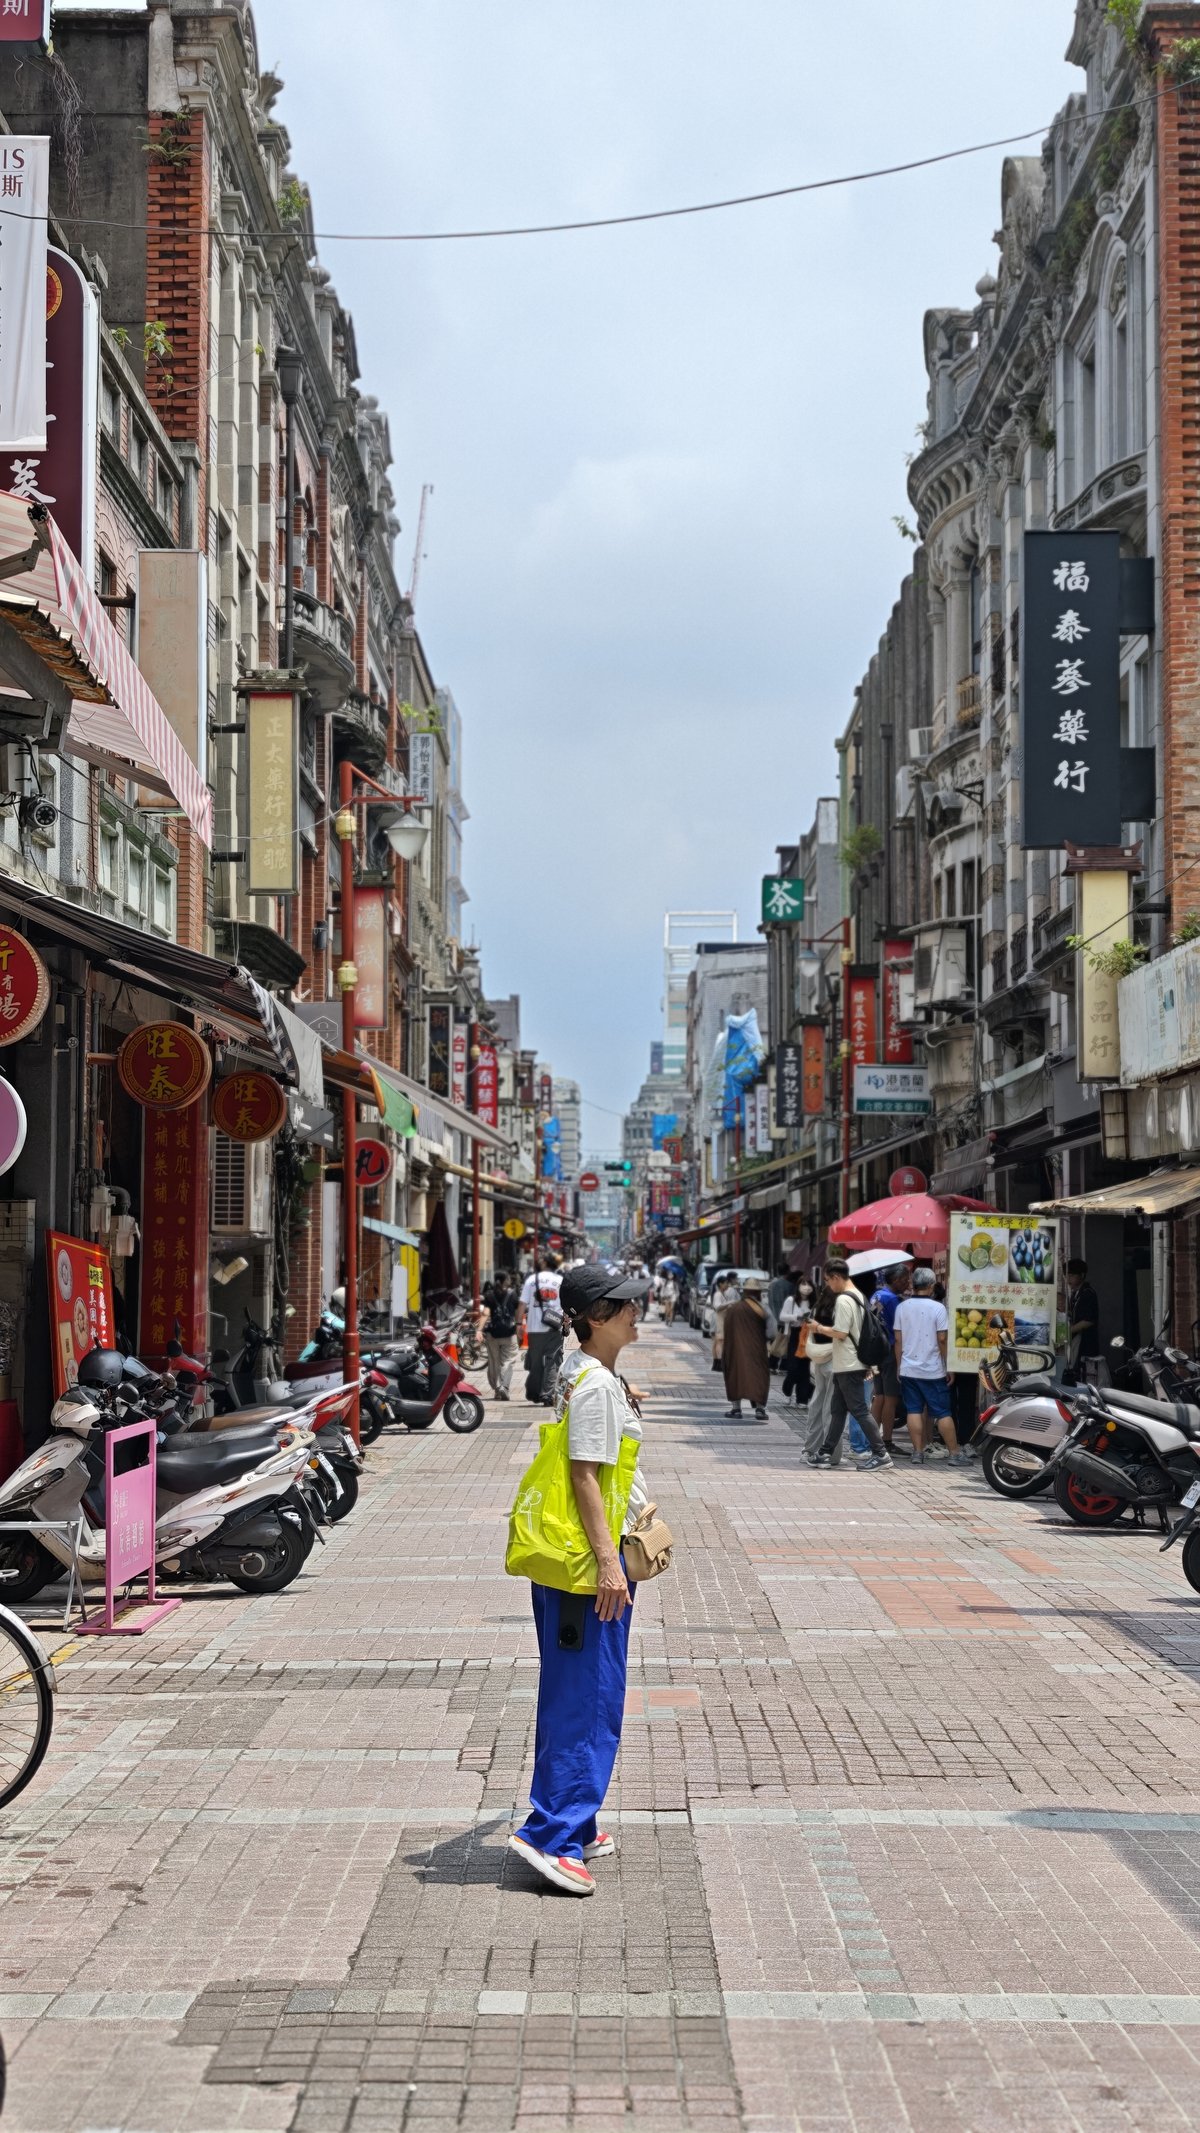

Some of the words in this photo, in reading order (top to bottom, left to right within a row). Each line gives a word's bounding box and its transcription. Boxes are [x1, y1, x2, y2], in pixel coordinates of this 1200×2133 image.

[2, 174, 24, 198] 斯
[1051, 561, 1092, 793] 福泰蔘藥行
[765, 881, 800, 918] 茶
[145, 1029, 184, 1099] 旺泰
[886, 1074, 924, 1087] 港香蘭
[234, 1079, 261, 1136] 旺泰
[979, 1216, 1036, 1229] 黑檸檬
